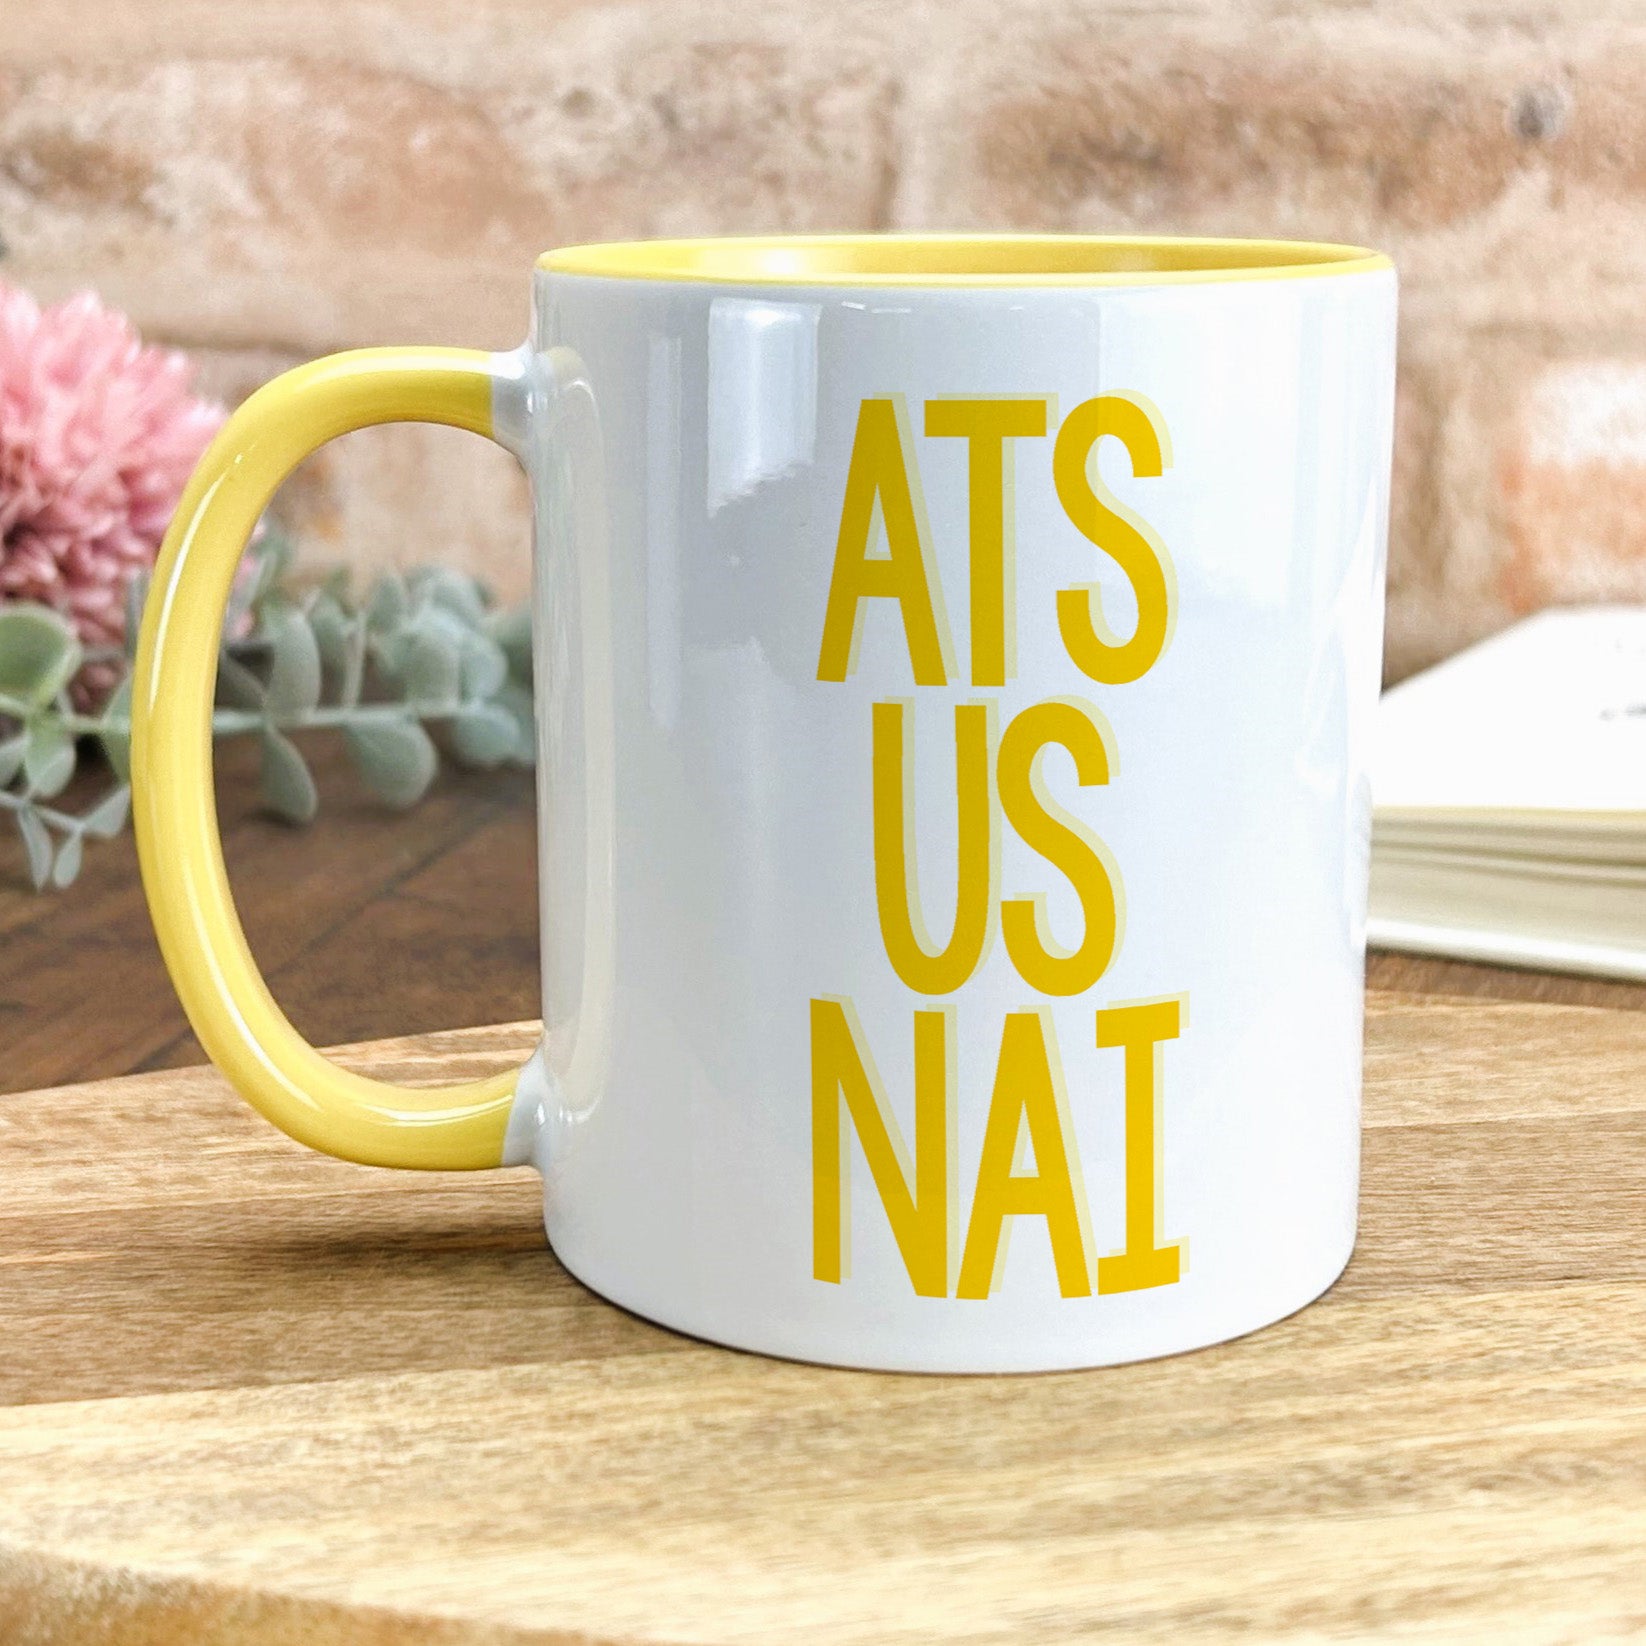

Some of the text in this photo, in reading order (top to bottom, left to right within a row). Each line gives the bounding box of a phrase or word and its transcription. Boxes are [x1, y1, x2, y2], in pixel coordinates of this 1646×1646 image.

[815, 393, 1175, 687] ATS
[871, 697, 1121, 997] US
[809, 995, 1186, 1301] NAI
